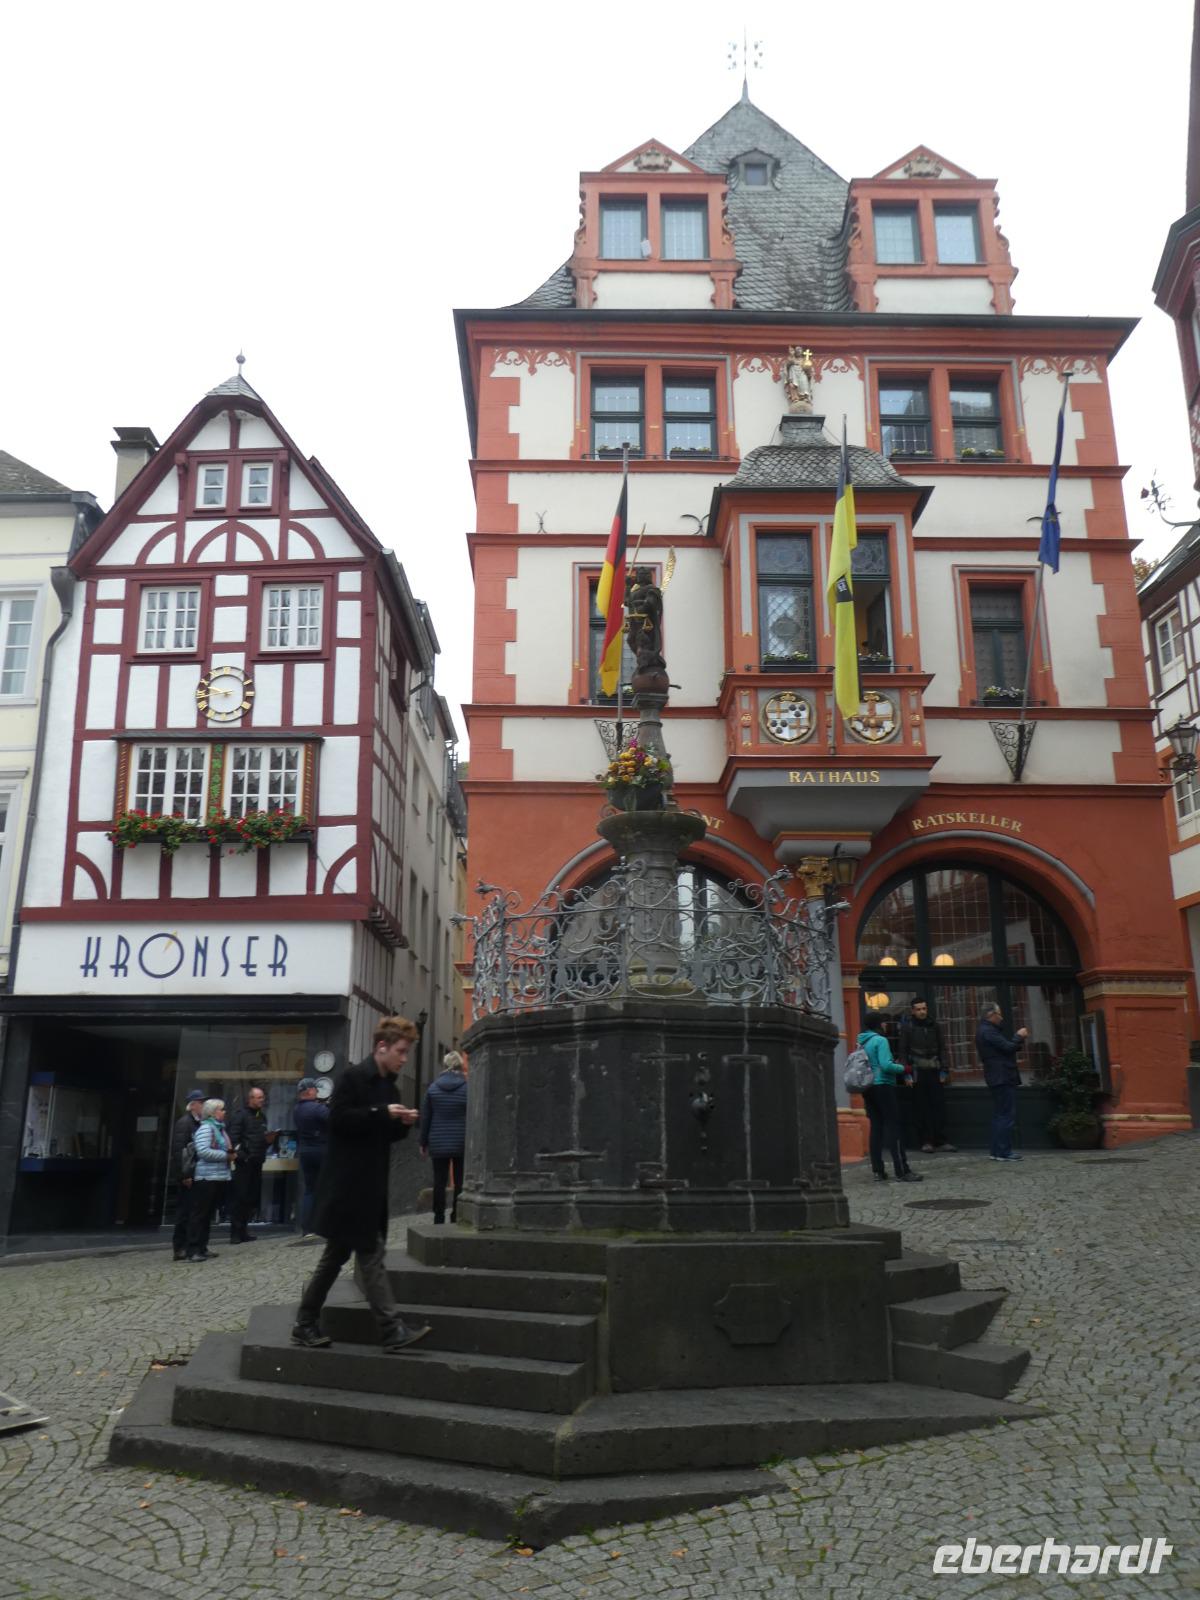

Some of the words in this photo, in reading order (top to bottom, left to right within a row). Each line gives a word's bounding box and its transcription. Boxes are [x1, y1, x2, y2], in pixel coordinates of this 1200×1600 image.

[789, 770, 880, 783] RATHAUS
[912, 812, 1022, 833] RATSKELLER
[80, 932, 288, 979] KRONSER
